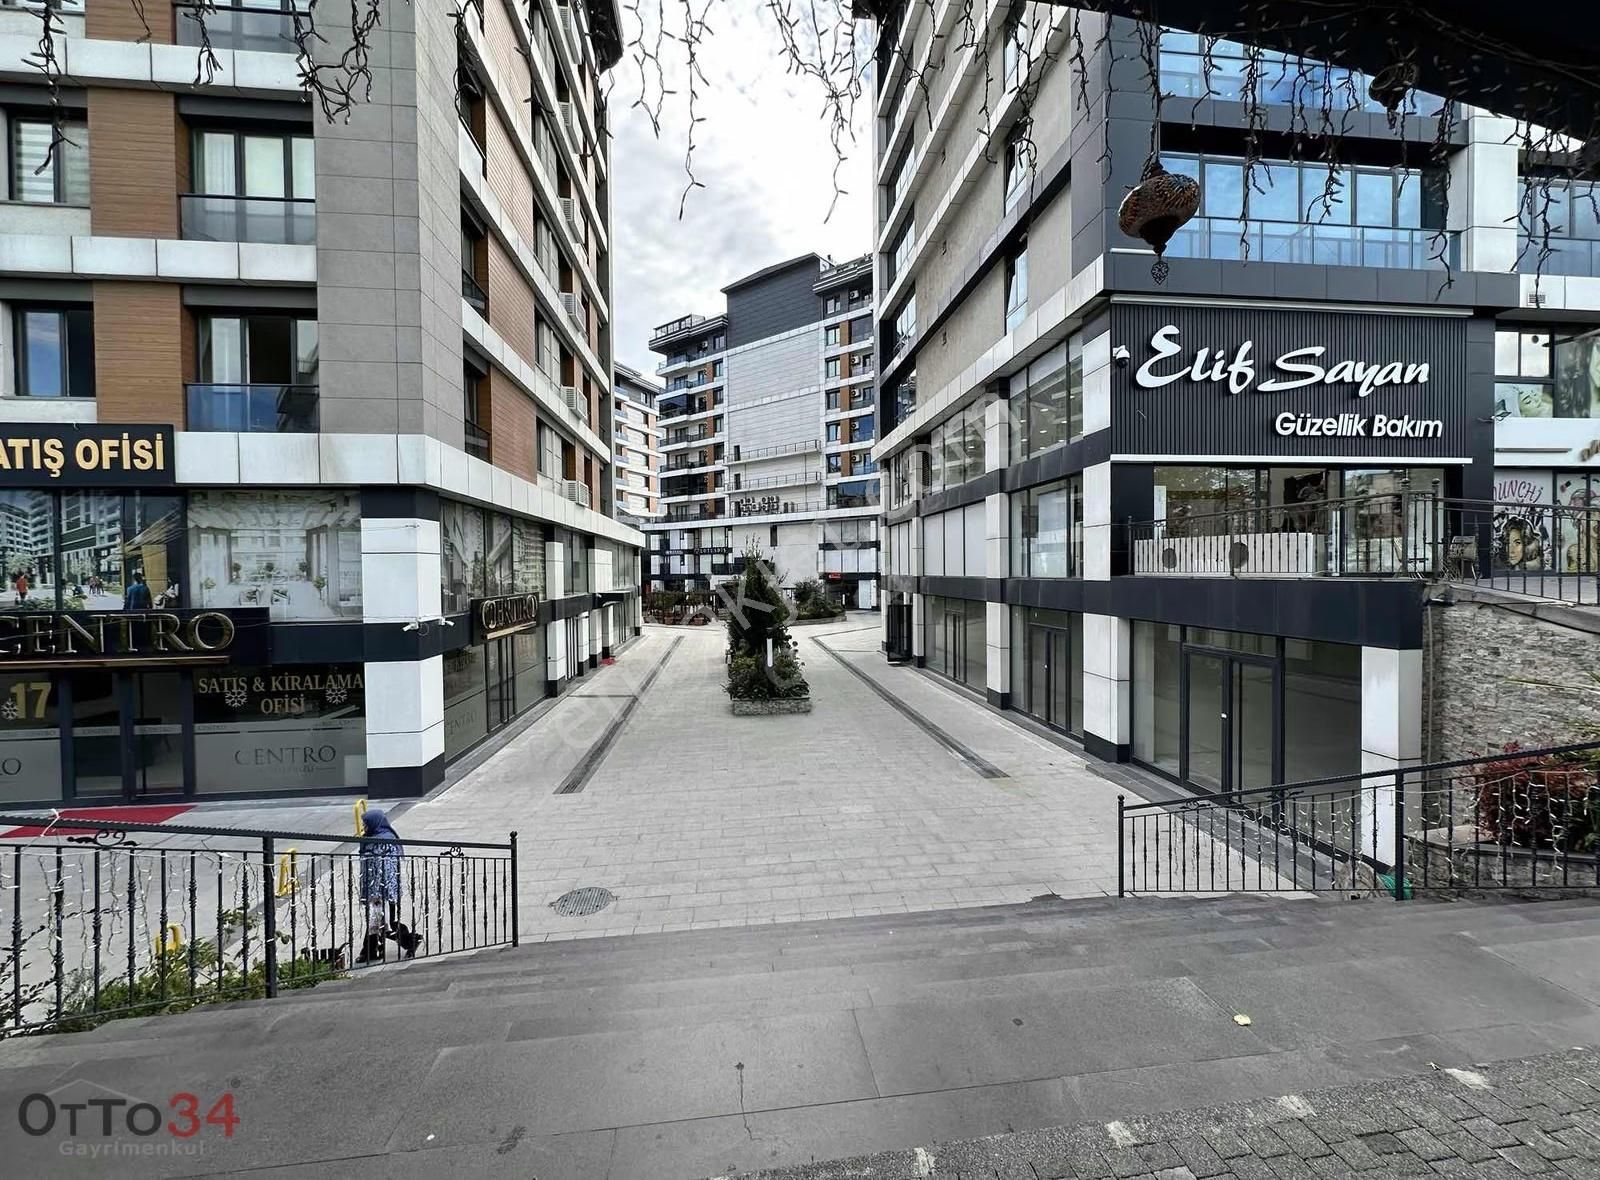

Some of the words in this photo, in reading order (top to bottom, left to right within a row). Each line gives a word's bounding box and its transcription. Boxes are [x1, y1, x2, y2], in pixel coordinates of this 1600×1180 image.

[1136, 325, 1255, 394] Elif
[1257, 346, 1430, 397] Sayan
[1275, 411, 1366, 437] Güzellik
[1372, 414, 1443, 438] Bakım
[75, 432, 165, 470] OFİSİ
[252, 676, 265, 692] &
[271, 672, 364, 691] KİRALAMA
[9, 682, 51, 719] 17
[261, 693, 306, 714] OFİSİ
[234, 744, 337, 766] CENTRO
